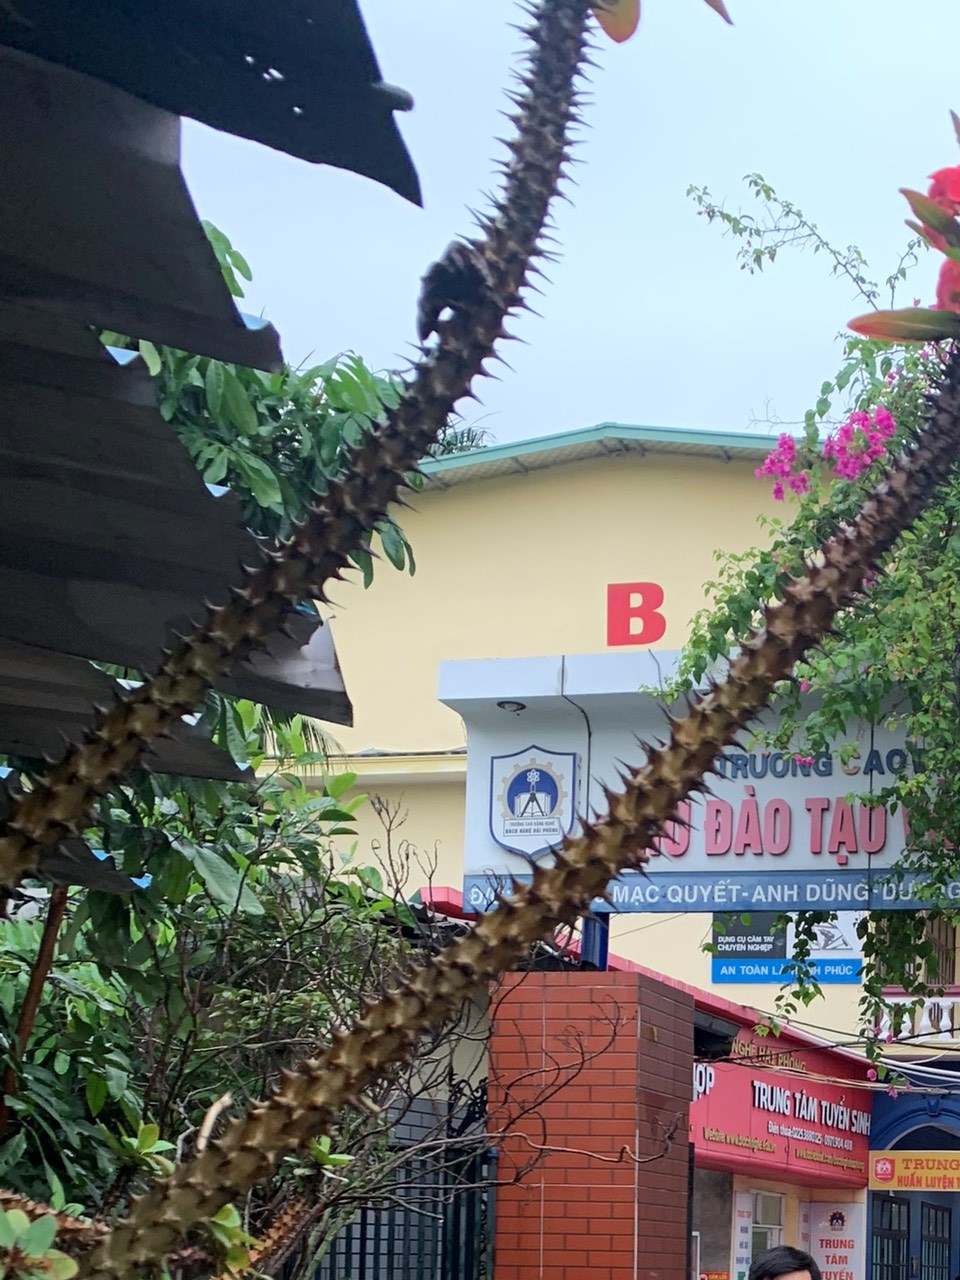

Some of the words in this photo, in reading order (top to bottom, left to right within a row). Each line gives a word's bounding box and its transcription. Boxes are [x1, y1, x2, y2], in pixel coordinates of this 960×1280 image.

[606, 582, 667, 646] B
[704, 784, 792, 856] ĐÀO
[612, 884, 660, 906] MẠC
[763, 935, 775, 943] TAY
[720, 965, 736, 975] AN
[740, 963, 769, 975] TOÀN
[825, 962, 853, 975] PHÚC
[753, 1080, 791, 1116] TRUNG
[794, 1089, 818, 1123] TÂM
[821, 1095, 850, 1128] TUYỂN
[851, 1109, 872, 1136] SINH
[901, 1158, 960, 1171] TRUNG
[897, 1171, 922, 1188] HUẤN
[925, 1173, 955, 1189] LUYỆN
[819, 1238, 854, 1249] TRUNG
[825, 1253, 848, 1265] TÂM
